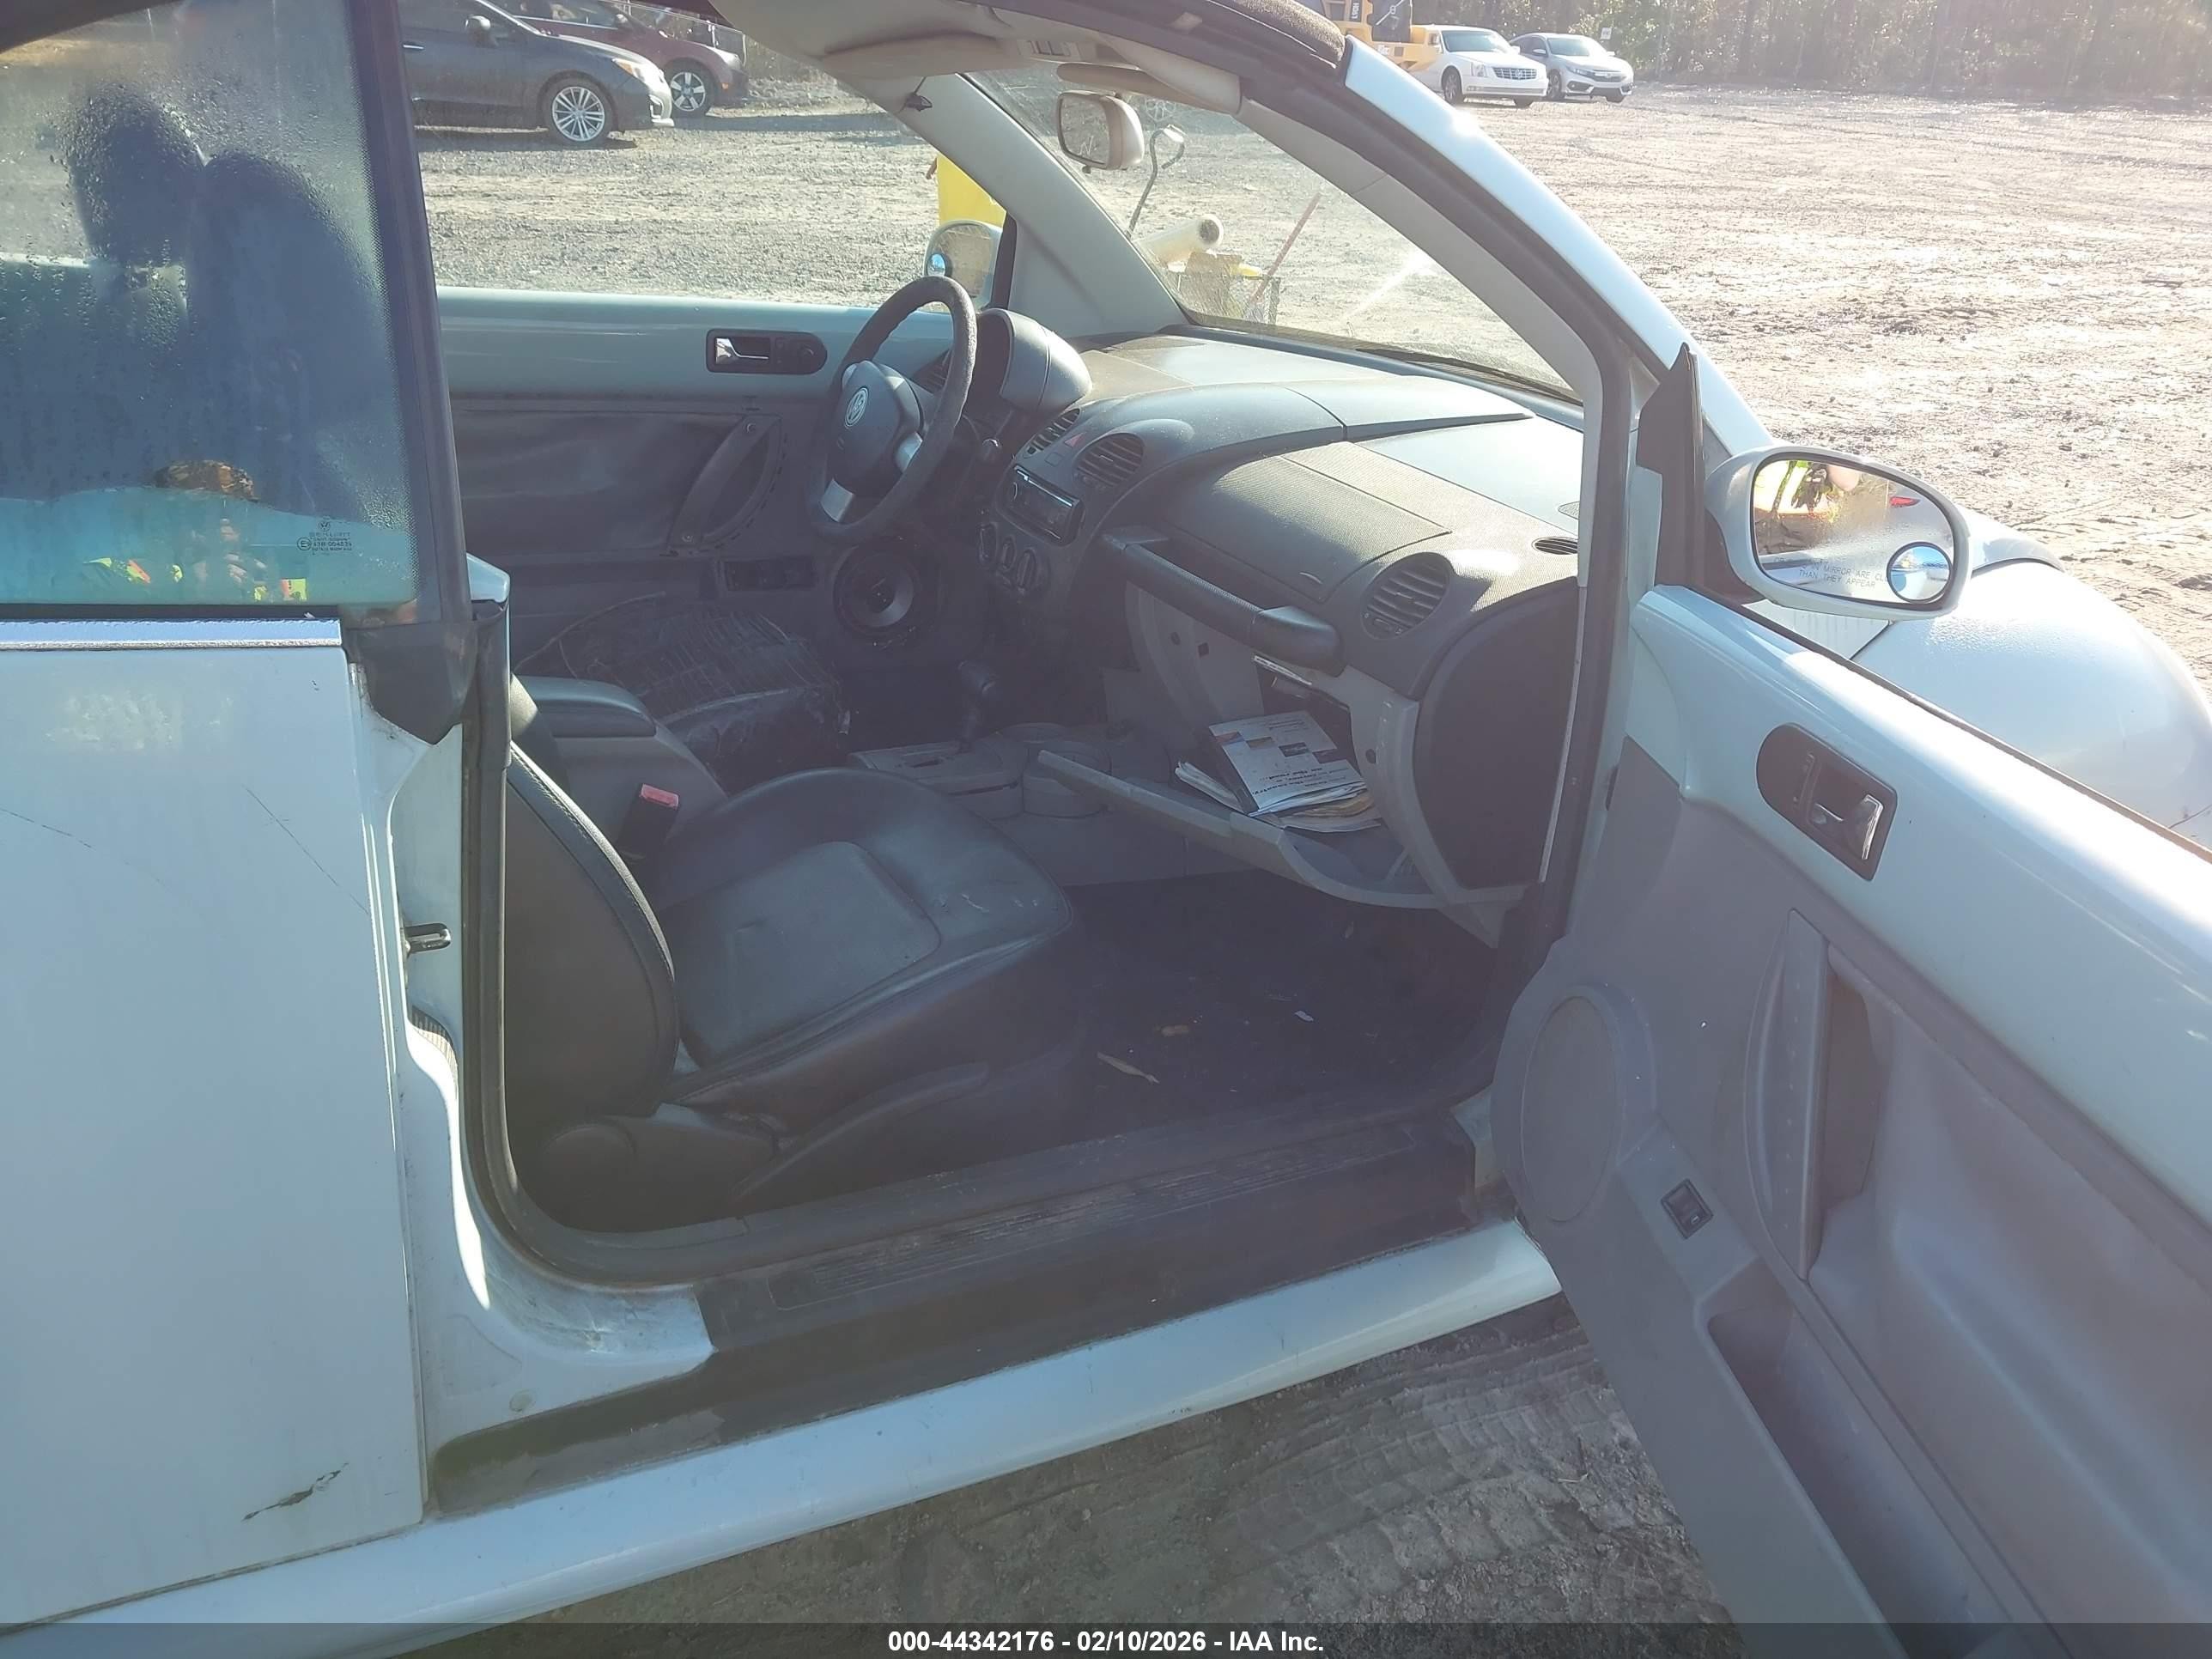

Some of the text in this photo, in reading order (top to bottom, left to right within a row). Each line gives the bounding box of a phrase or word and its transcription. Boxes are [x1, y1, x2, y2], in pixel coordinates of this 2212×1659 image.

[1799, 569, 1876, 588] THAN THEY APPEAR
[1823, 564, 1854, 576] MIRROR
[1856, 569, 1871, 580] ARE
